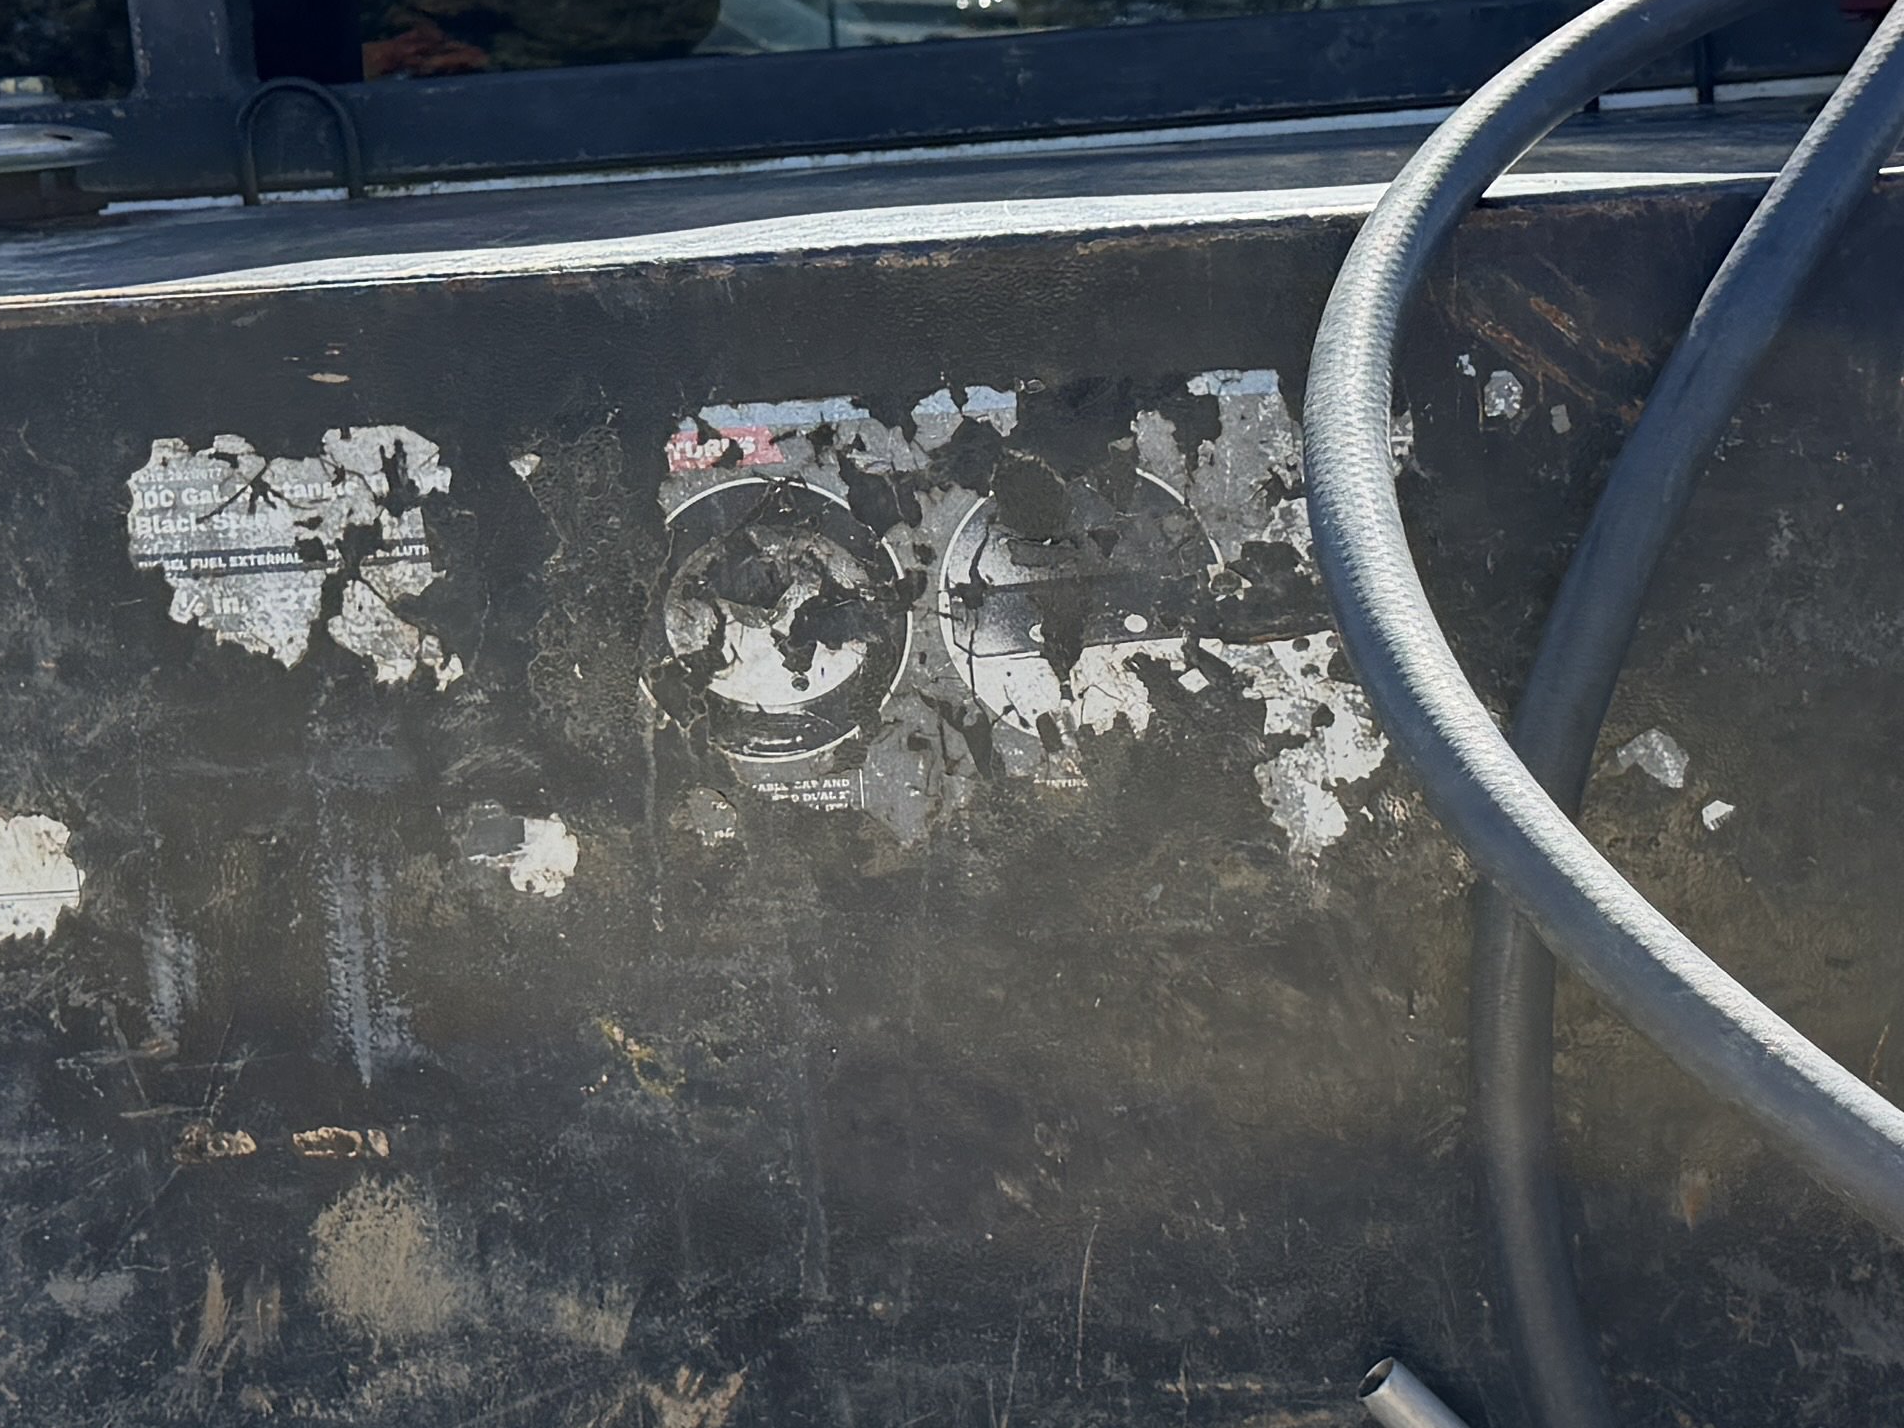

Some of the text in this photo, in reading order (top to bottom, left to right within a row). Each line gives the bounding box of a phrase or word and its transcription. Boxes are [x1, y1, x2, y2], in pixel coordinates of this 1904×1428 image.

[136, 512, 208, 535] Black
[191, 556, 227, 570] FUEL
[229, 552, 303, 568] EXTERNAL
[823, 777, 850, 789] AND
[802, 790, 837, 802] DUAL
